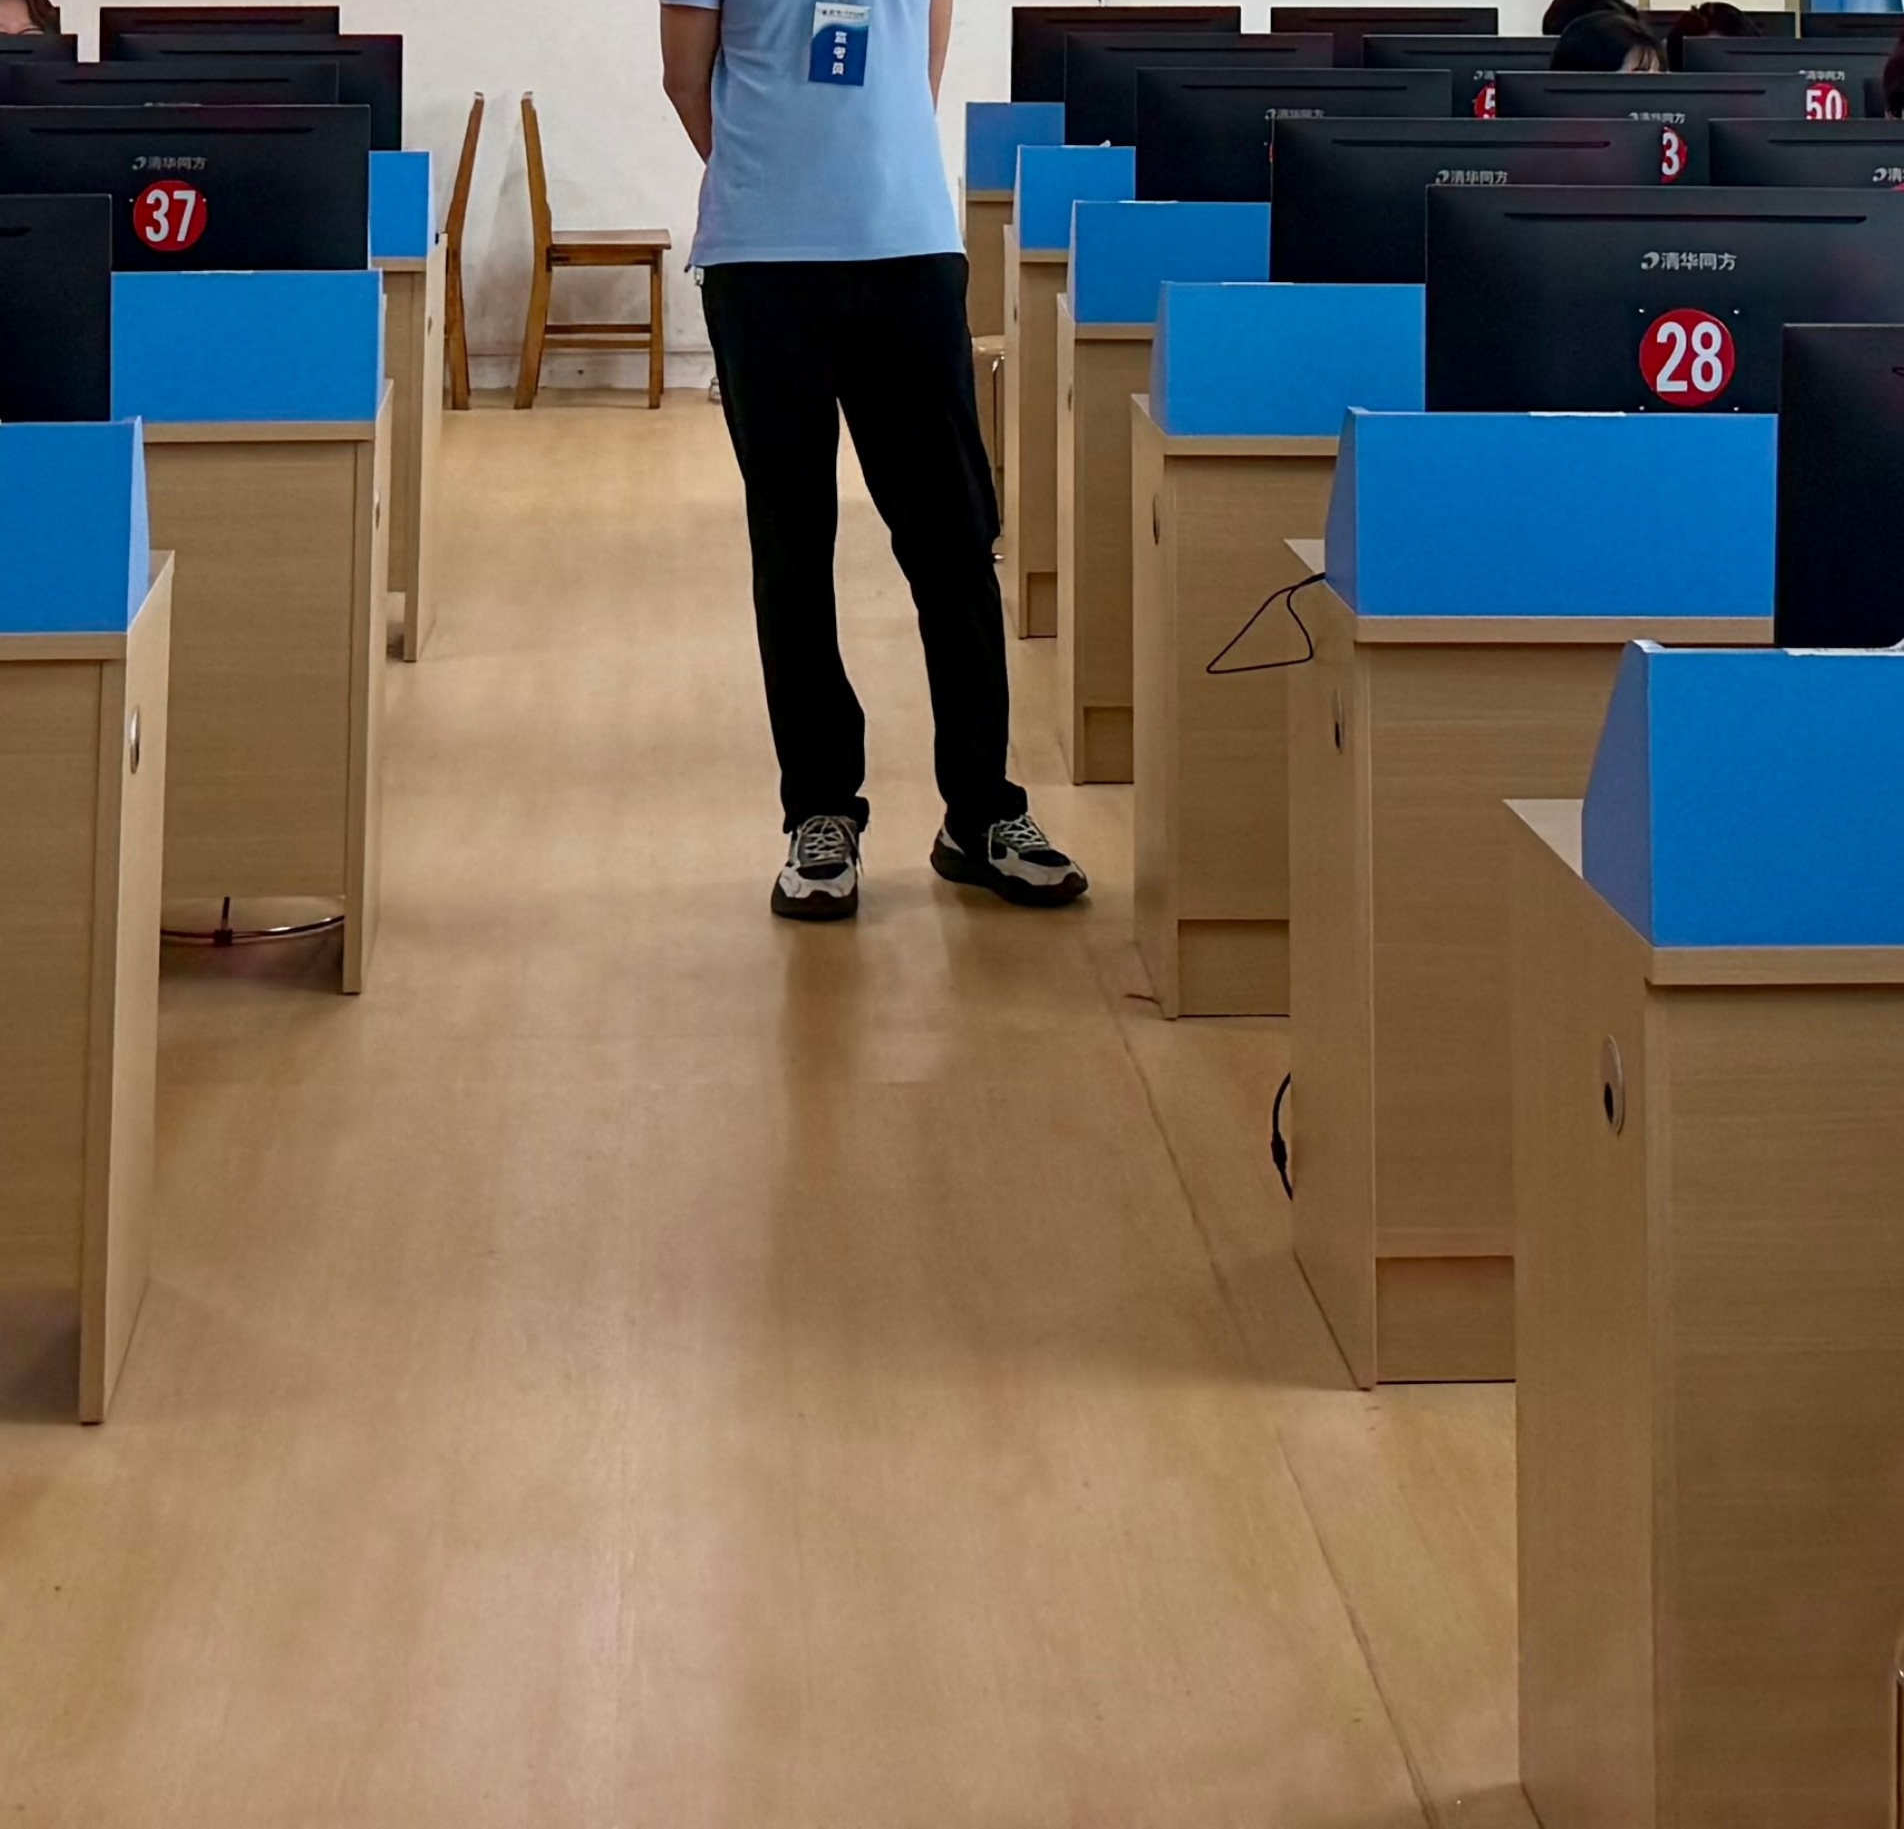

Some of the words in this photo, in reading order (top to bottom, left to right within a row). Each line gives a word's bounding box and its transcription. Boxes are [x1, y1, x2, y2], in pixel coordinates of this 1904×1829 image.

[1806, 89, 1843, 120] 50
[146, 188, 197, 242] 37
[1661, 252, 1737, 271] 清华同方
[1656, 321, 1725, 393] 28
